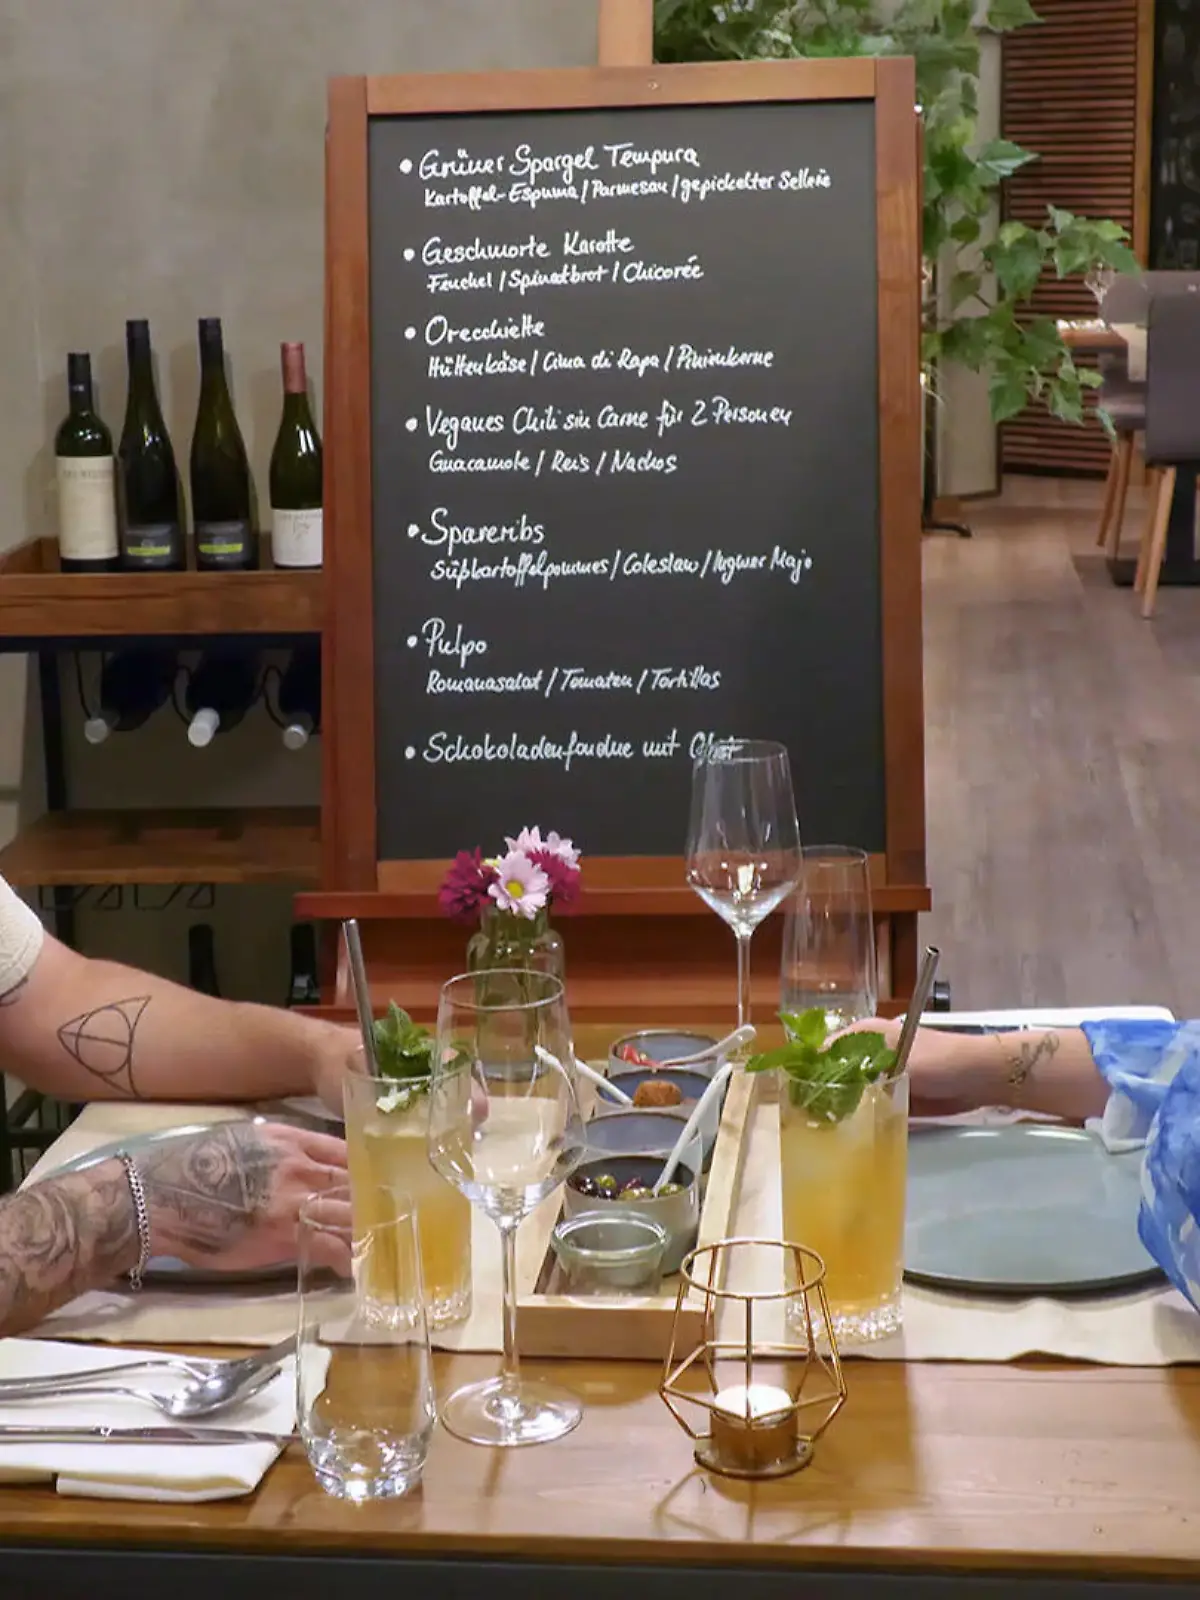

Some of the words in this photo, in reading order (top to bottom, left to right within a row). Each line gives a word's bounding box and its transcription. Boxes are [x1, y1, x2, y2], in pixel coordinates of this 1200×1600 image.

[419, 148, 504, 180] Grüner
[509, 144, 600, 186] Spargel
[603, 142, 700, 175] Tempura
[591, 179, 668, 199] Parmesan
[680, 170, 775, 204] gepickelter
[422, 234, 551, 266] Geschmorte
[563, 229, 635, 256] Karotte
[427, 271, 493, 293] Fenchel
[508, 264, 609, 295] Spinatbrot
[623, 255, 704, 284] Chicorée
[425, 313, 545, 346] Orecchiette
[428, 350, 528, 378] Hüttenkäse
[543, 351, 586, 373] Cima
[591, 350, 615, 370] di
[617, 347, 660, 378] Rapa
[426, 405, 505, 450] Veganes
[512, 405, 562, 435] Chili
[562, 408, 592, 430] sin
[597, 404, 649, 429] Carne
[656, 399, 684, 437] für
[690, 399, 708, 427] 2
[711, 395, 793, 427] Personen
[429, 450, 531, 473] Guacamole
[551, 450, 591, 473] Reis
[610, 449, 679, 474] Nachos
[421, 507, 545, 557] Spareribs
[623, 551, 699, 576] Coleslaw
[713, 549, 767, 585] Ingwer
[769, 545, 813, 584] Majo
[421, 617, 488, 668] Pulpo
[426, 668, 544, 694] Romanasalat
[560, 667, 634, 690] Tomaten
[650, 664, 721, 690] Tortillas
[422, 730, 635, 772] Schokoladenfondue
[642, 727, 681, 757] mit
